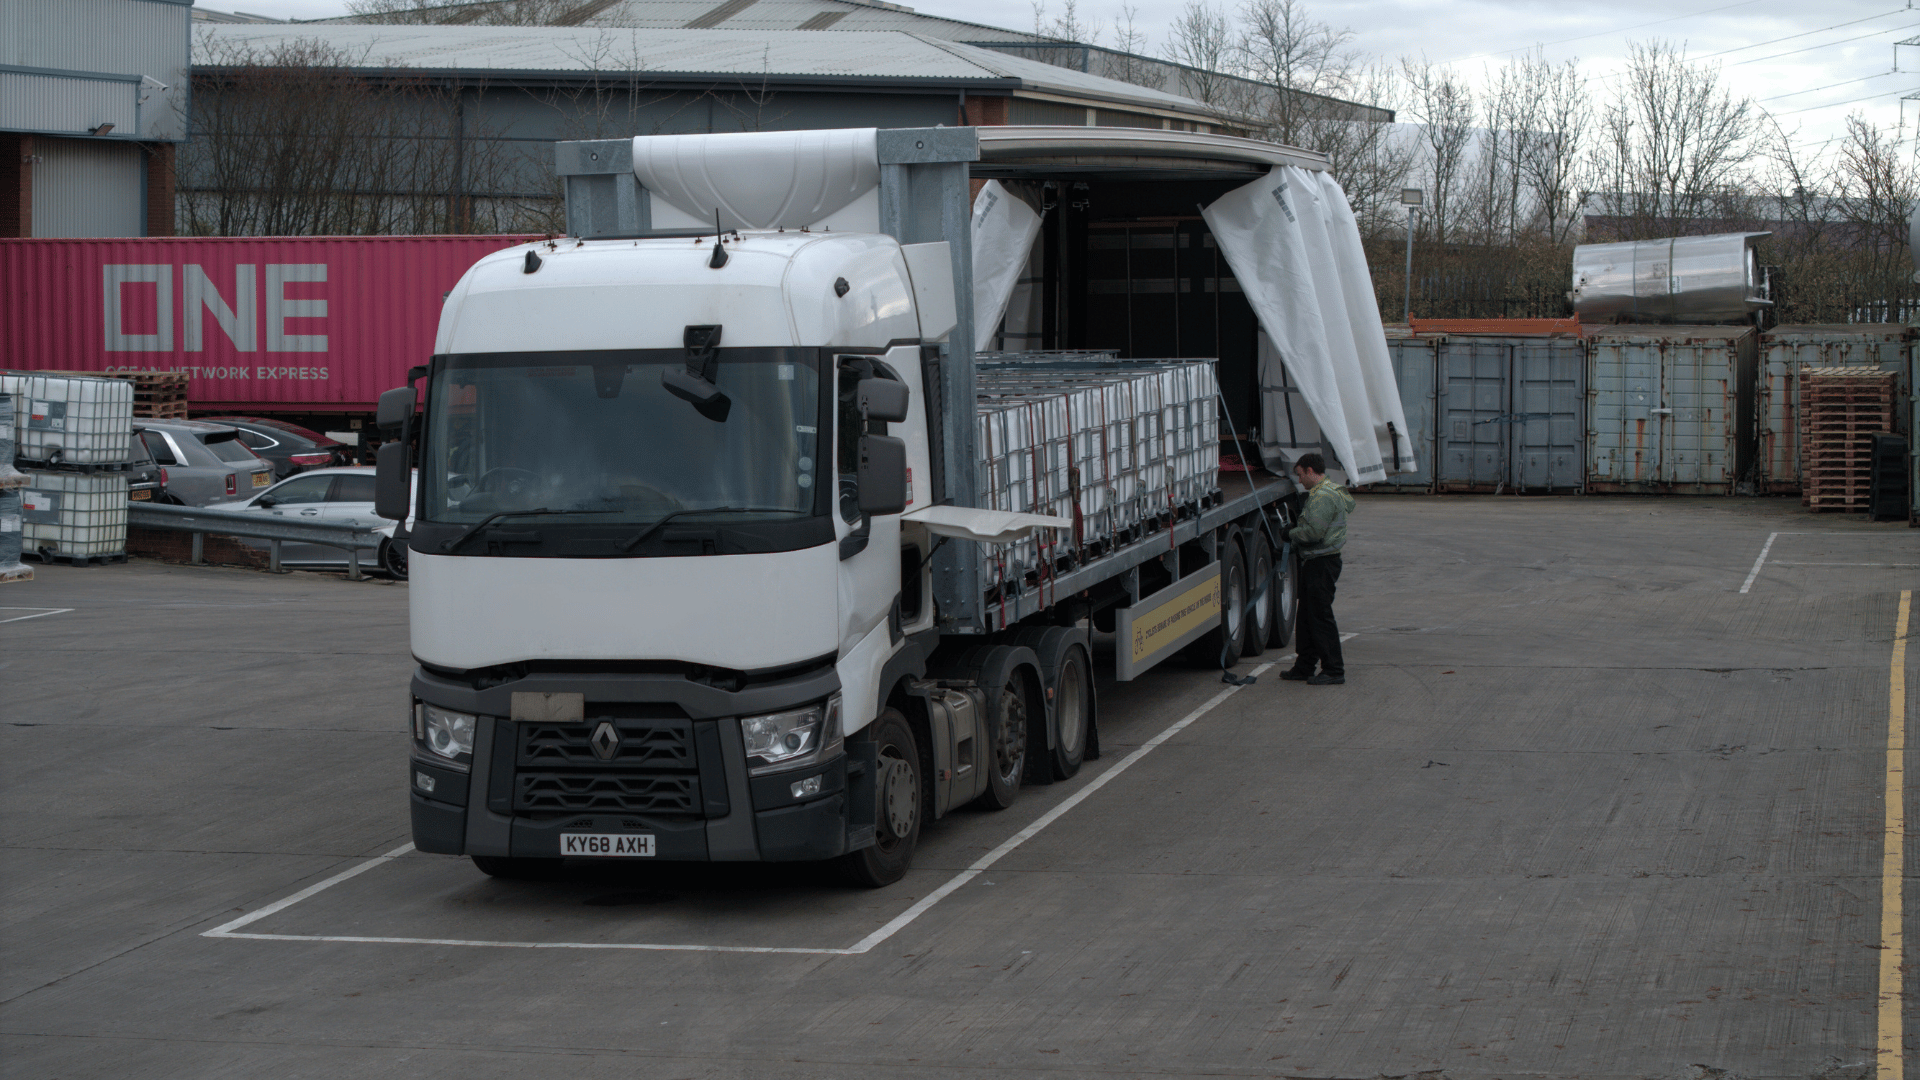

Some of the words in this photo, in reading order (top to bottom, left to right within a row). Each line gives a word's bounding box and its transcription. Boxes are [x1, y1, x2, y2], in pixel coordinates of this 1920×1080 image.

[103, 263, 328, 352] ONE
[257, 366, 329, 380] EXPRESS
[566, 836, 610, 853] KY68
[615, 837, 648, 854] AXH
